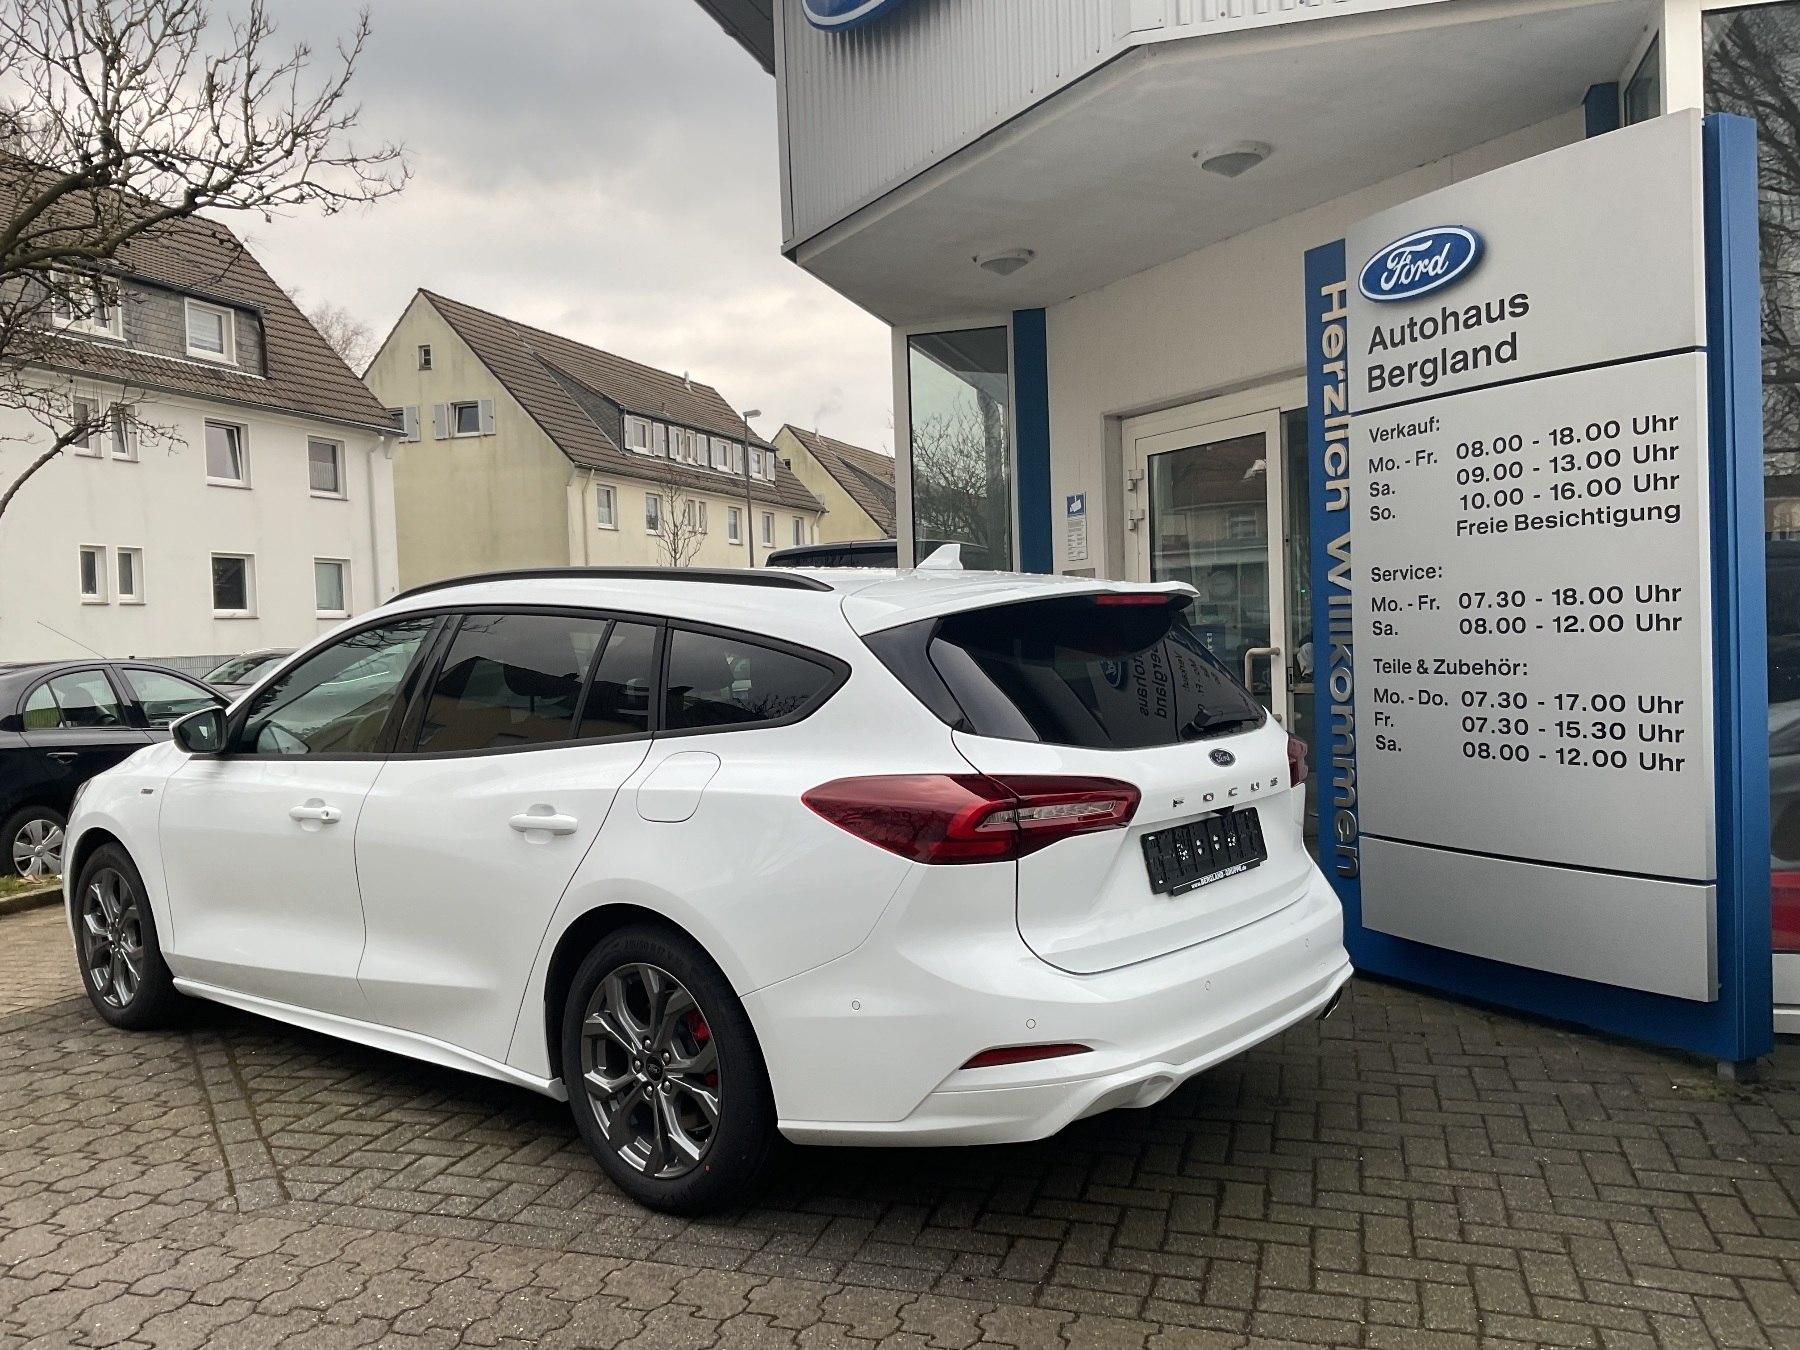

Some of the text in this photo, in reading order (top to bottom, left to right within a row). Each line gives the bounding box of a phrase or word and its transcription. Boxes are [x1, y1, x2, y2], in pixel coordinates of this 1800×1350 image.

[1380, 239, 1452, 291] Ford
[1367, 293, 1530, 356] Autohaus
[1367, 331, 1518, 394] Bergland
[1321, 280, 1350, 512] Herzlich
[1368, 416, 1440, 444] Verkauf:
[1456, 434, 1523, 460] 08.00
[1549, 420, 1621, 450] 18.00
[1632, 414, 1679, 436] Uhr
[1369, 481, 1396, 498] Sa.
[1456, 461, 1524, 486] 09.00
[1549, 448, 1621, 475] 13.00
[1632, 443, 1680, 466] Uhr
[1370, 505, 1397, 521] So.
[1459, 488, 1524, 511] 10.00
[1550, 477, 1622, 503] 16.00
[1633, 472, 1680, 495] Uhr
[1457, 503, 1681, 537] Freie Besichtigung
[1371, 564, 1443, 583] Service:
[1458, 590, 1526, 610] 07.30
[1552, 586, 1624, 608] 18.00
[1635, 584, 1682, 605] Uhr
[1372, 621, 1399, 637] Sa.
[1459, 617, 1527, 636] 08.00
[1552, 613, 1624, 634] 12.00
[1636, 613, 1683, 633] Uhr
[1373, 657, 1528, 677] Teile & Zubehör:
[1327, 530, 1358, 878] Willkommen
[1461, 691, 1528, 710] 07.30
[1554, 693, 1626, 714] 17.00
[1638, 695, 1685, 715] Uhr
[1374, 711, 1394, 728] Fr.
[1462, 716, 1529, 736] 07.30
[1555, 720, 1626, 742] 15.30
[1638, 724, 1685, 744] Uhr
[1375, 735, 1402, 753] Sa.
[1463, 742, 1530, 763] 08.00
[1555, 748, 1628, 771] 12.00
[1639, 751, 1686, 773] Uhr
[1172, 777, 1279, 808] FOCUS
